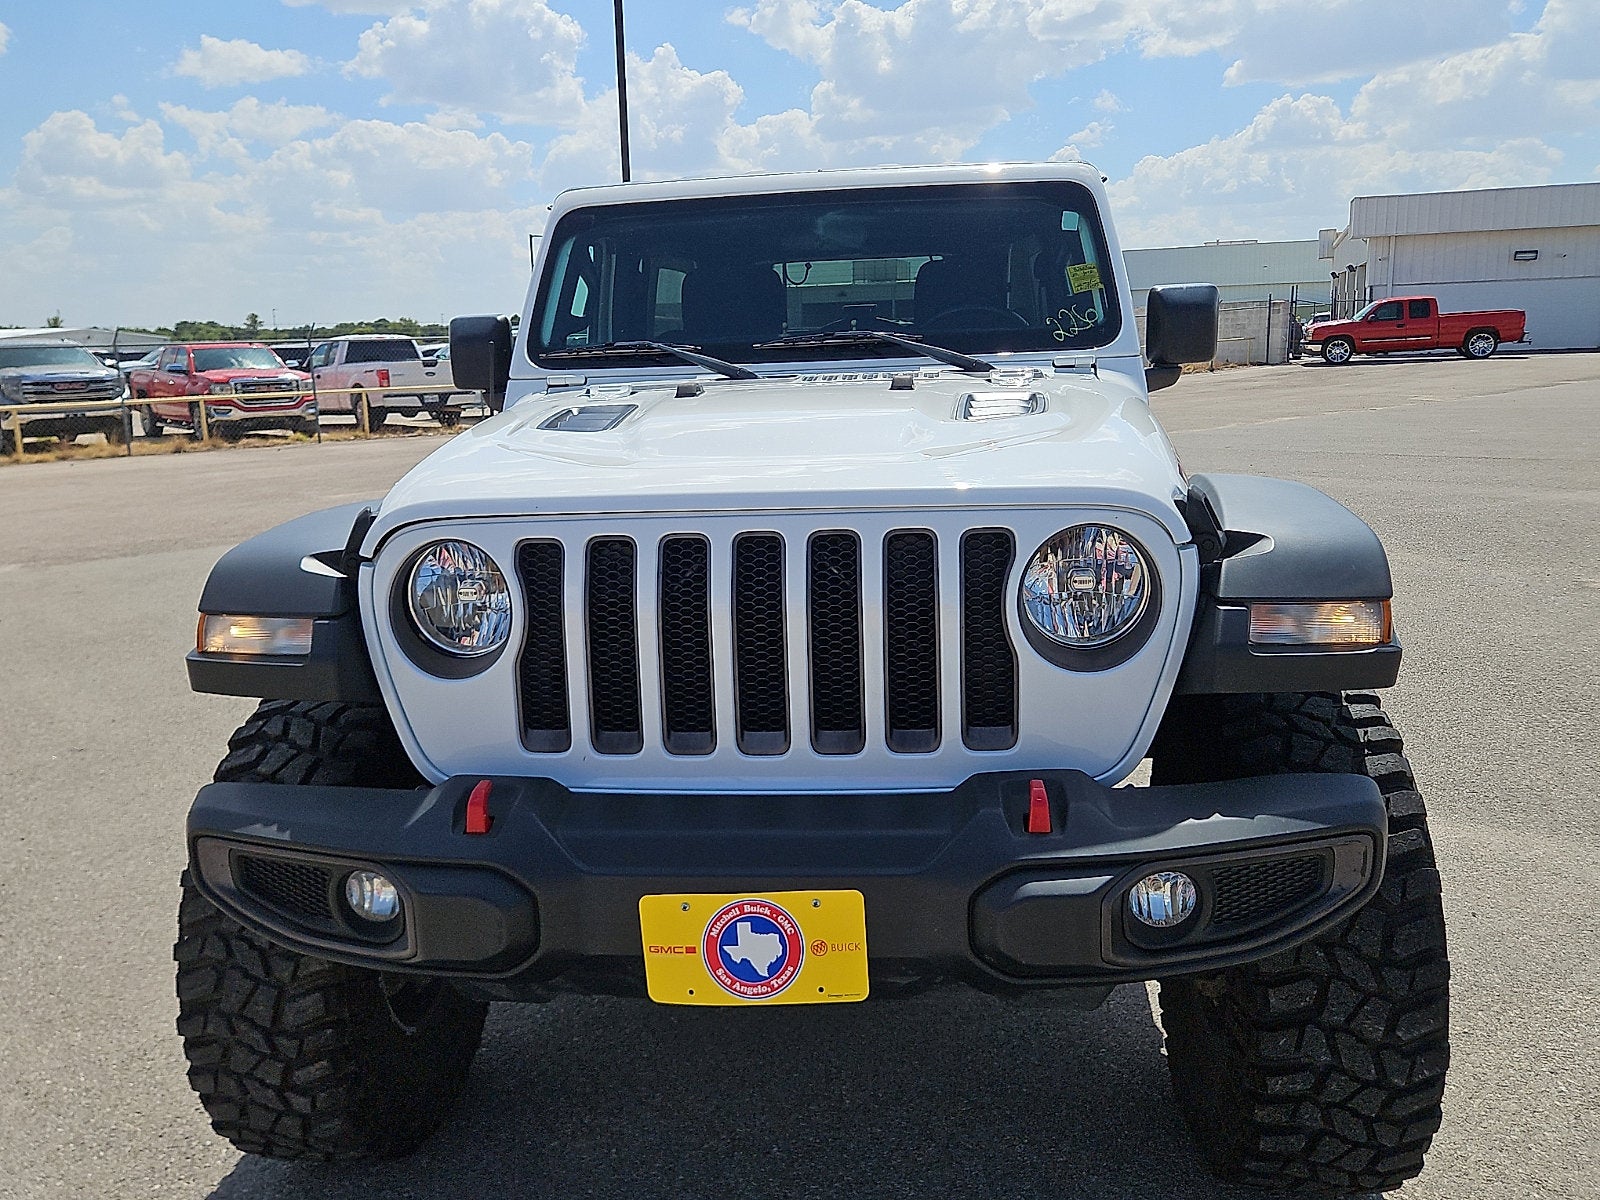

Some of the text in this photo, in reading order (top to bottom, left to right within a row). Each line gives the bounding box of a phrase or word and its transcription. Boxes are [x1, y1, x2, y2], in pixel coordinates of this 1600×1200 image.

[1046, 304, 1099, 342] 226
[709, 907, 741, 938] Mitchell
[743, 904, 772, 915] Buick
[777, 915, 795, 936] GMC
[649, 945, 684, 954] GMC
[831, 943, 861, 952] BUICK
[715, 965, 794, 995] San Angelo, Texas
